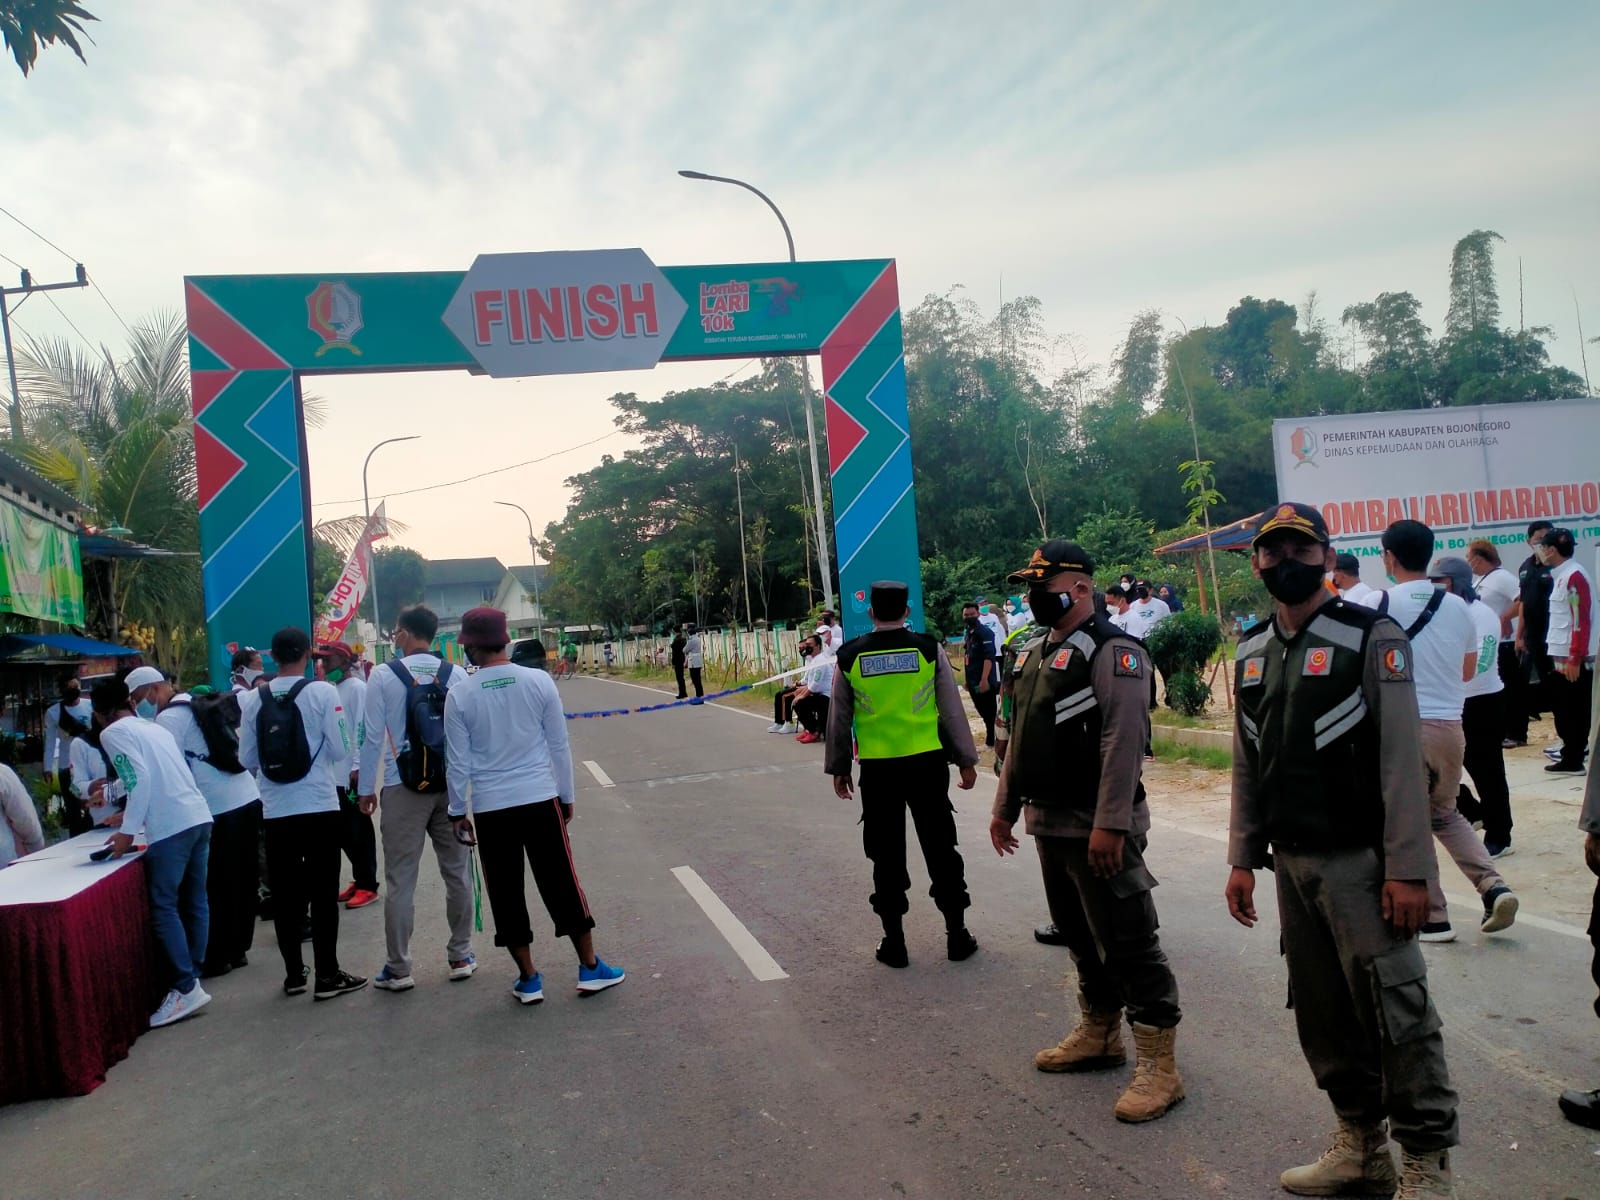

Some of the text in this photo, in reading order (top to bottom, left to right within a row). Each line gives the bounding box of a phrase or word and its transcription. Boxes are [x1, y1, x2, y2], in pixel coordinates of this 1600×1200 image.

[700, 280, 749, 297] Lomba
[472, 282, 660, 345] FINISH
[700, 294, 749, 315] LARI
[1323, 421, 1511, 443] PEMERINTAH KABUPATEN BOJONEGORO
[1324, 436, 1499, 458] DINAS KEPEMUDAAN DAN OLAHRAGA
[1311, 498, 1404, 535] OMBA
[1474, 482, 1600, 523] MARATHO
[330, 574, 356, 607] HOT
[862, 654, 918, 673] POLISI
